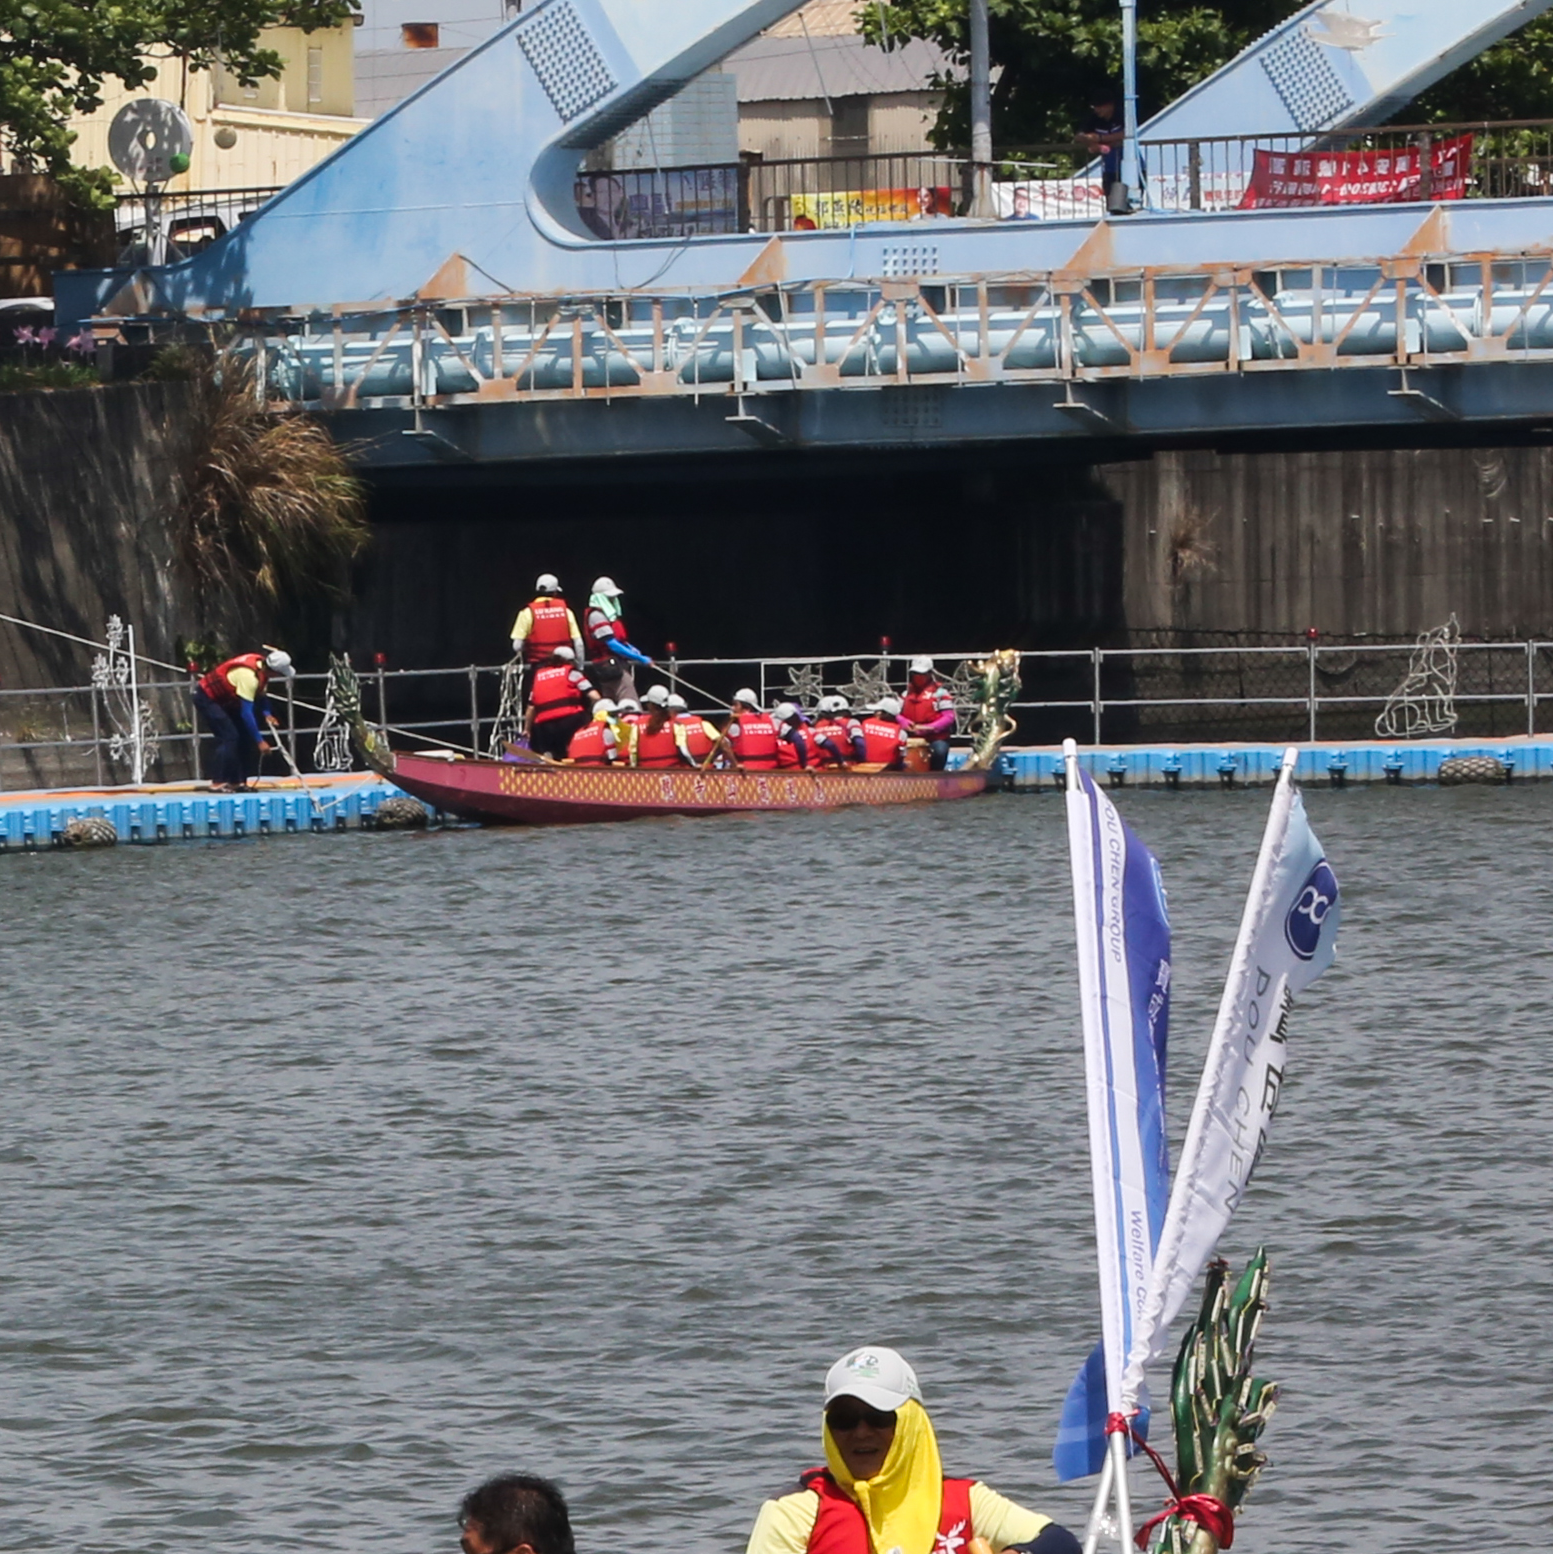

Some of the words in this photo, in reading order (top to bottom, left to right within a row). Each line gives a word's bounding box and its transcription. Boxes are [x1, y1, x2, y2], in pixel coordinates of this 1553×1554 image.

[1109, 838, 1122, 890] CHEN
[1109, 895, 1122, 964] GROUP
[1243, 965, 1271, 1067] POU
[1223, 1086, 1250, 1213] CHEN
[1130, 1210, 1146, 1279] Welfare
